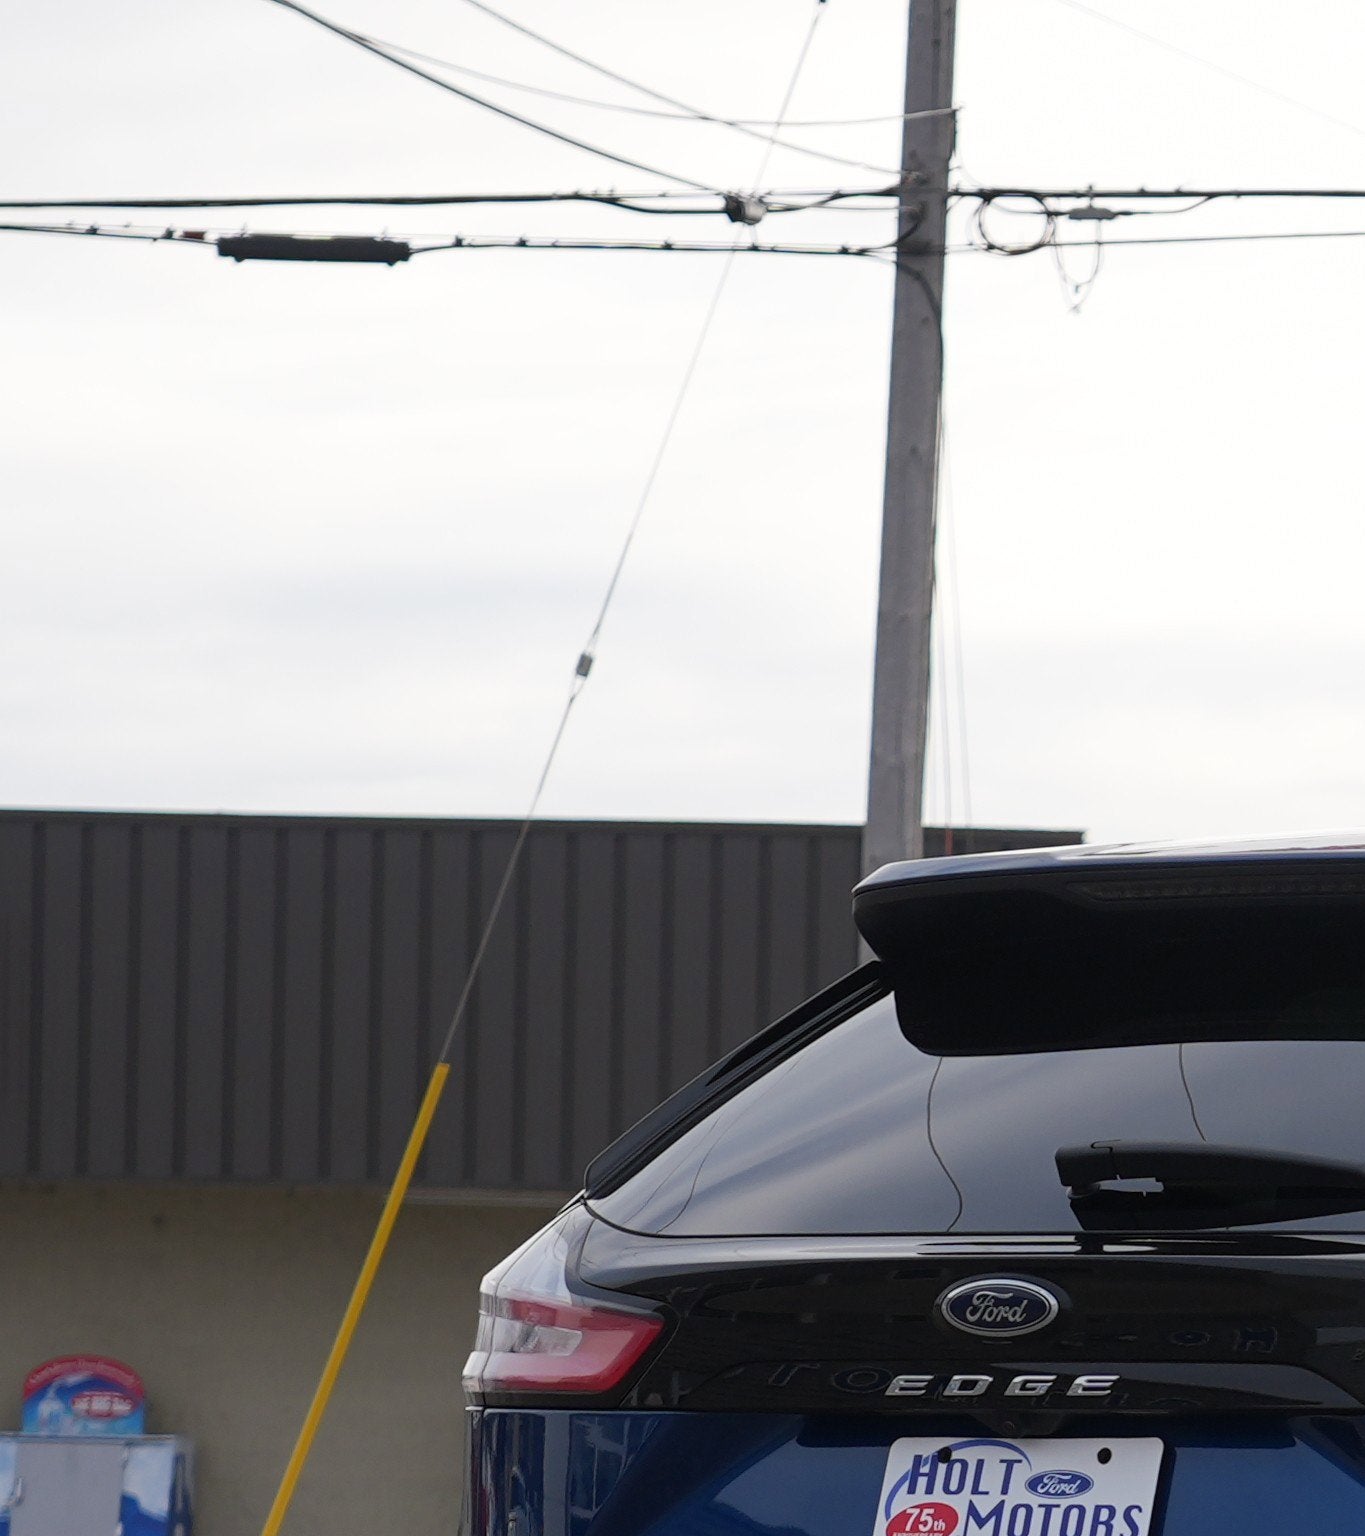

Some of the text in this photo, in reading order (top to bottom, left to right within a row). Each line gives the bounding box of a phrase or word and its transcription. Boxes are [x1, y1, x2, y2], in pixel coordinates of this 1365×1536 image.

[965, 1290, 1028, 1323] Ford
[884, 1374, 1121, 1397] EDGE
[906, 1454, 1023, 1496] HOLT
[1036, 1472, 1083, 1495] Ford
[905, 1508, 946, 1532] 75th
